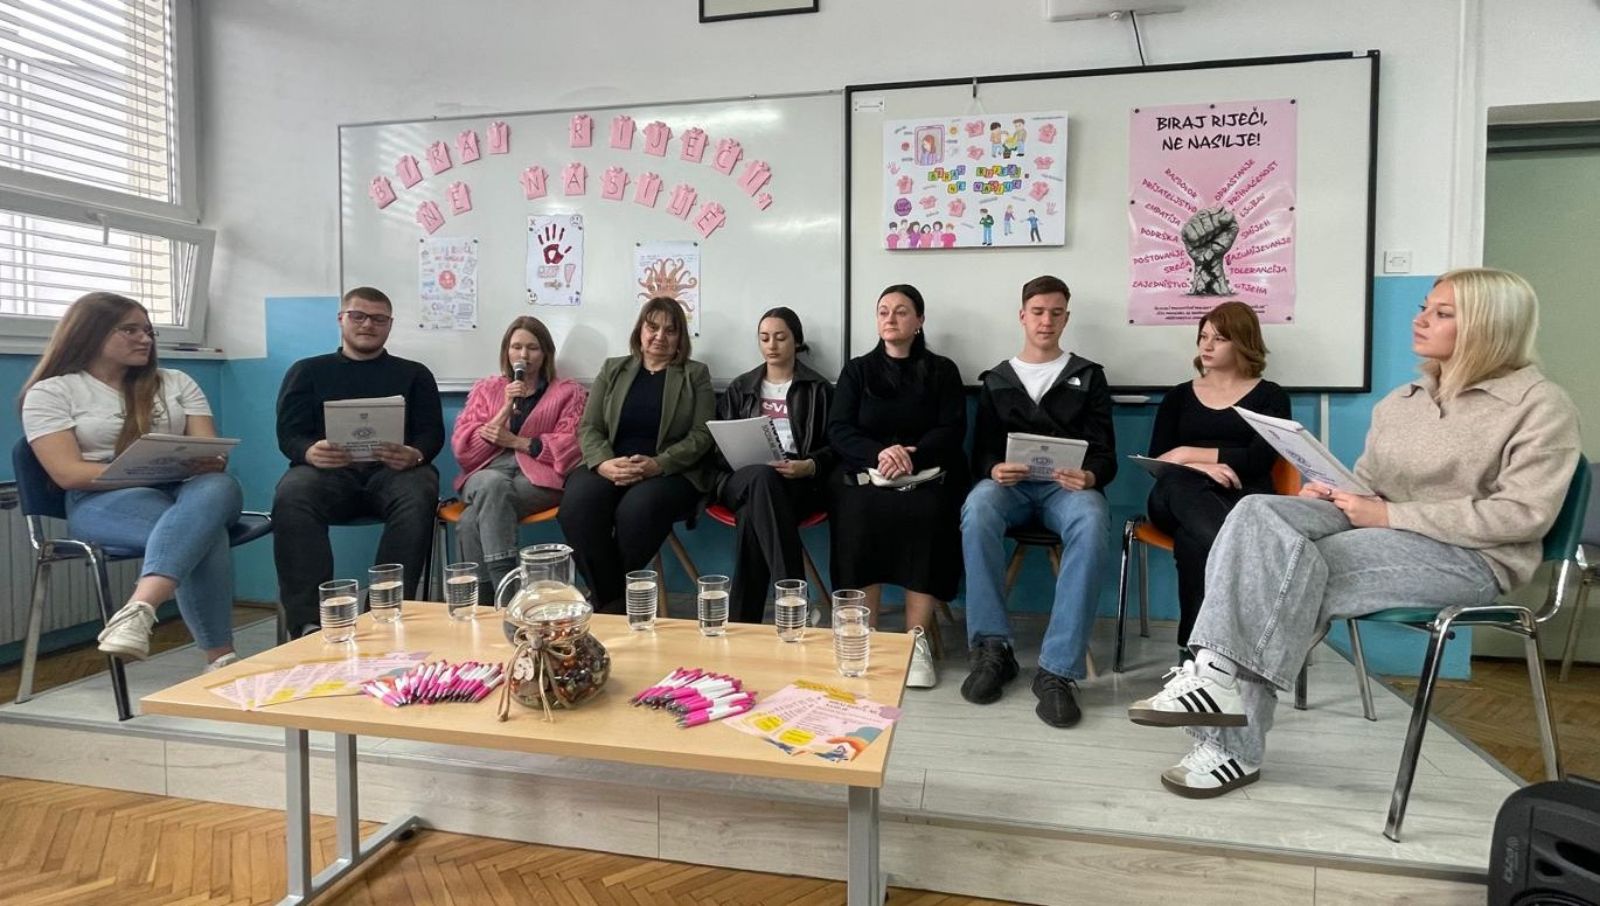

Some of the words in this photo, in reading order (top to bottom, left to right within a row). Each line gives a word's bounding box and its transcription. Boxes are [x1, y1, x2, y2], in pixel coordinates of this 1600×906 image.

[1156, 116, 1207, 131] BIRAJ
[1211, 106, 1267, 127] RIJEČI,
[1162, 136, 1184, 150] NE
[1188, 132, 1260, 149] NASILJE!
[373, 123, 506, 202] BIRAJ
[423, 188, 468, 227] NE
